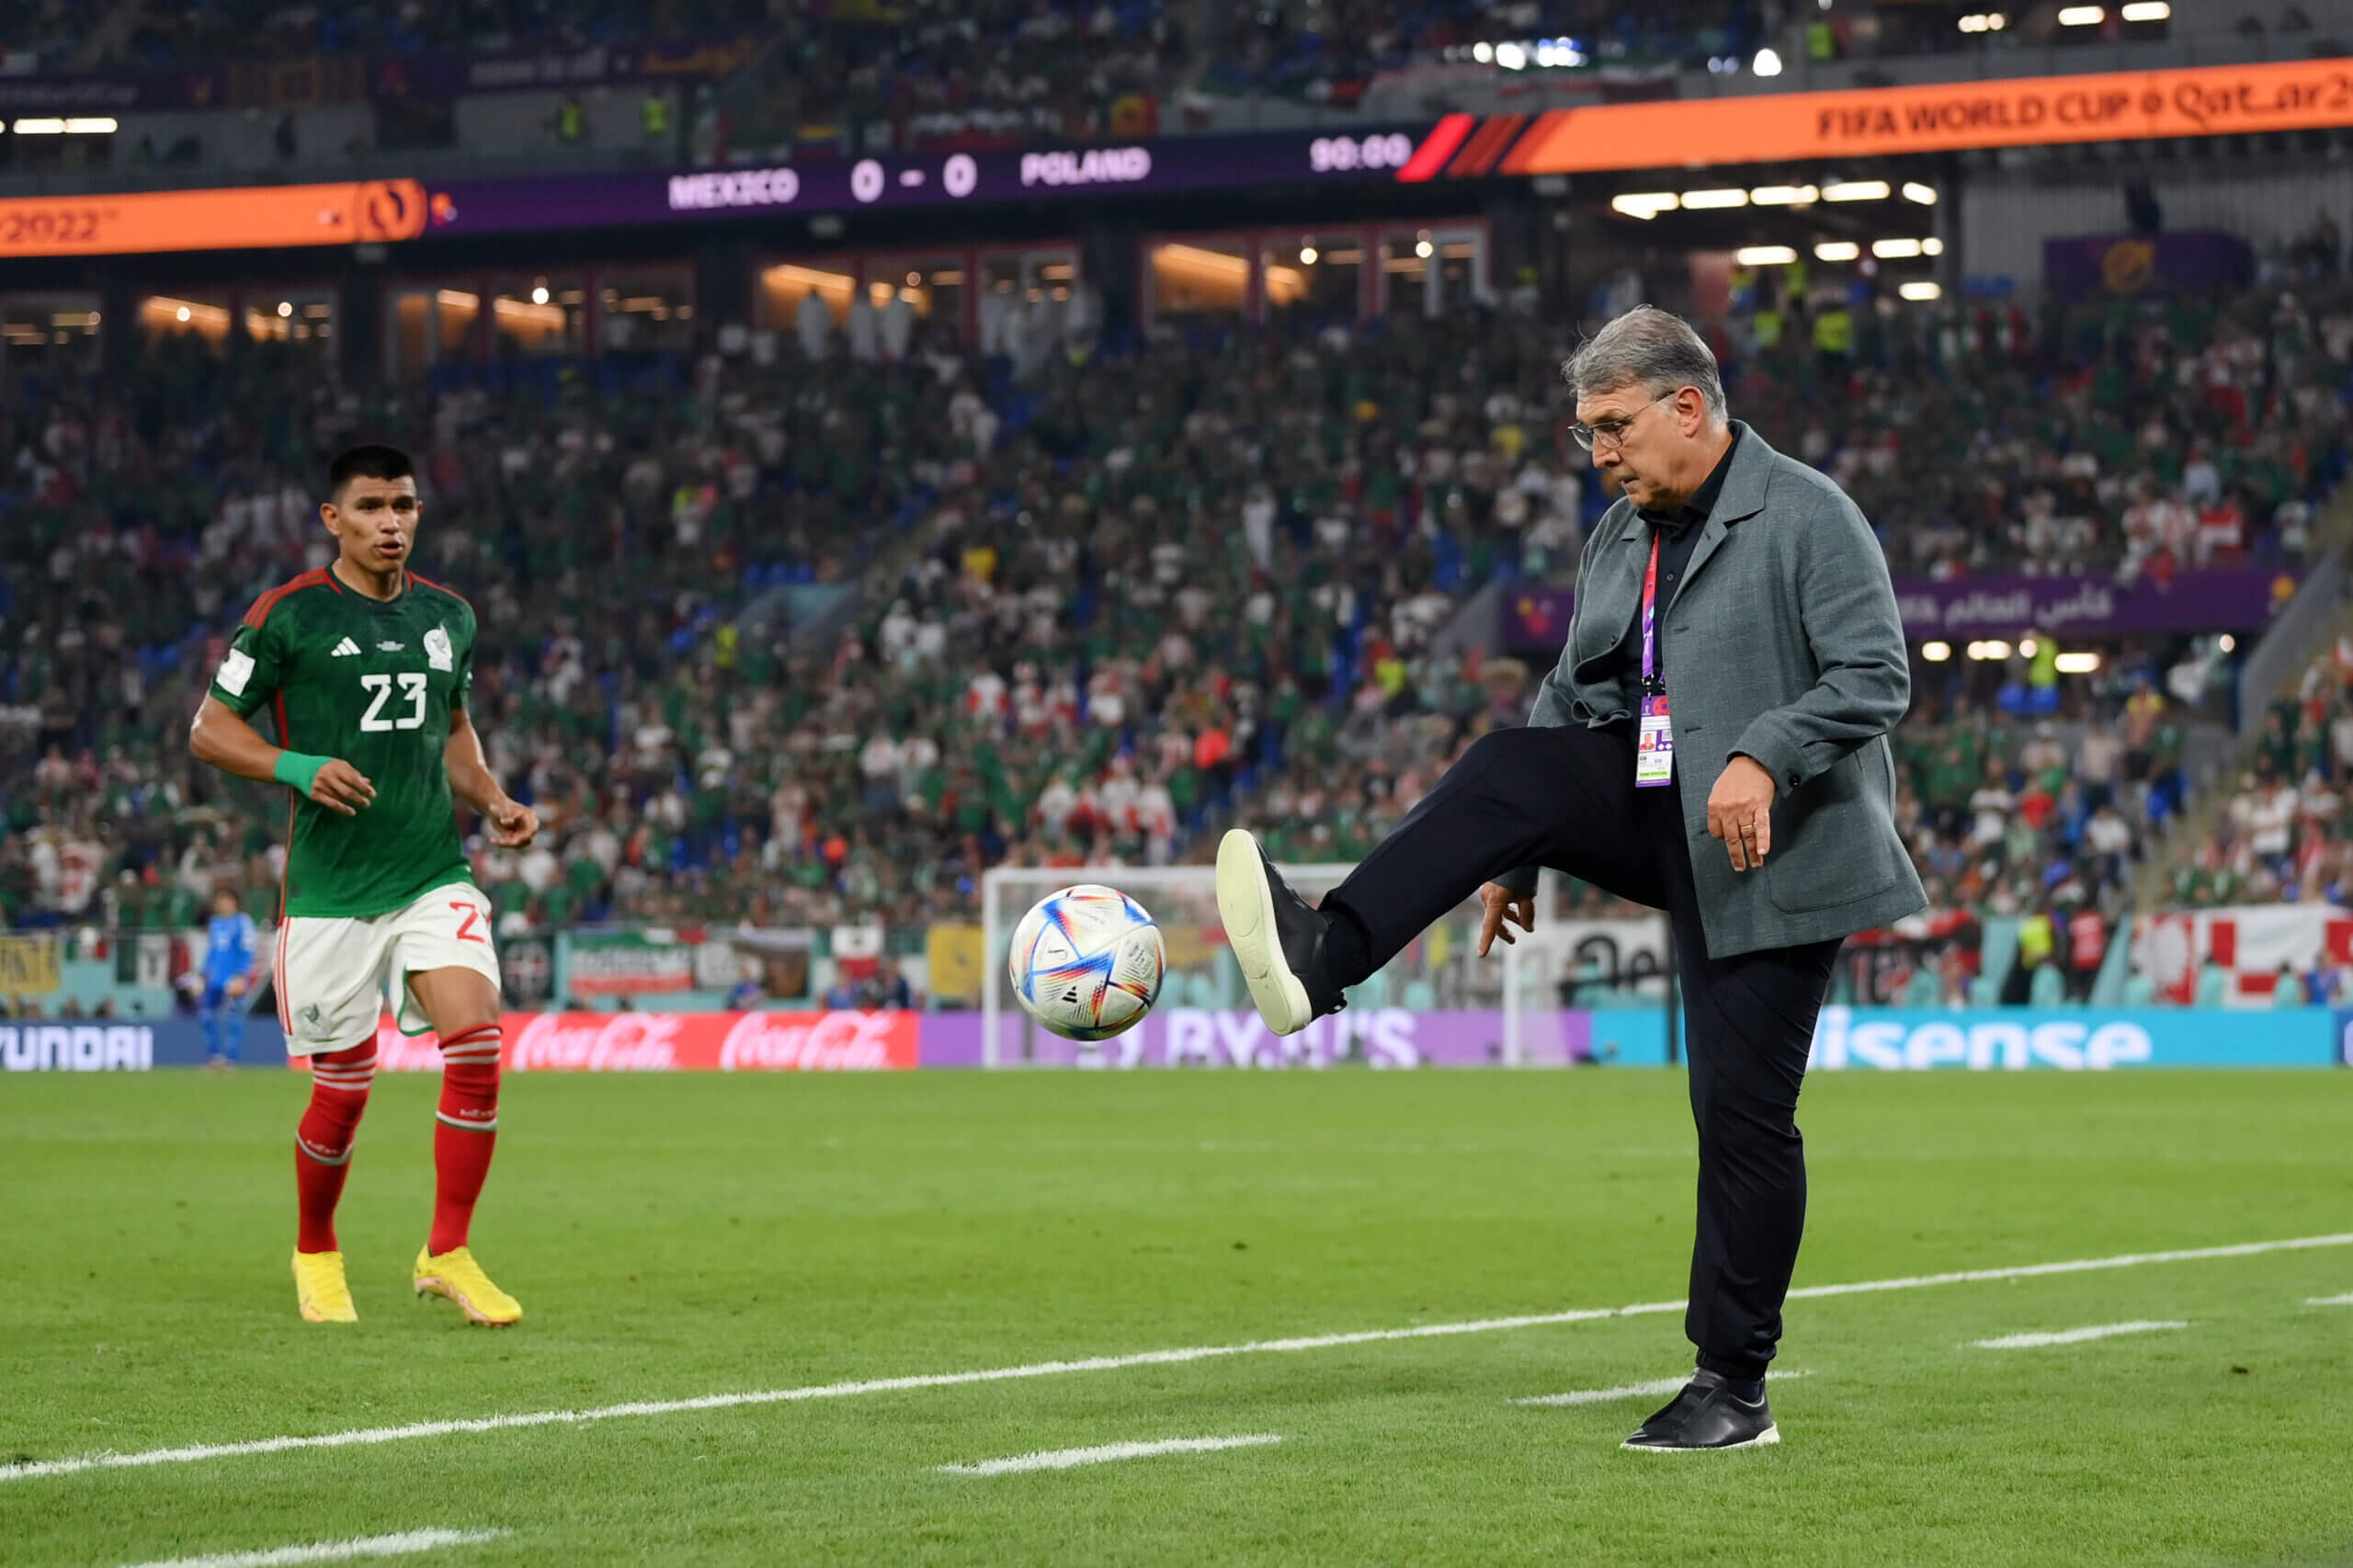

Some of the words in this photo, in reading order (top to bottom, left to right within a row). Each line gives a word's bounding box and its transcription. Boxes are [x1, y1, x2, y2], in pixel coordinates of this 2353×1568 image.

[1817, 106, 1899, 137] FIFA
[1905, 94, 2045, 133] WORLD
[2057, 91, 2130, 126] CUP
[668, 167, 799, 210] MEXICO
[850, 158, 884, 203] 0
[943, 153, 977, 198] 0
[1021, 147, 1151, 186] POLAND
[1310, 133, 1412, 172] 90:00
[360, 673, 427, 732] 23
[449, 902, 493, 944] 2
[1808, 1005, 2153, 1069] isense
